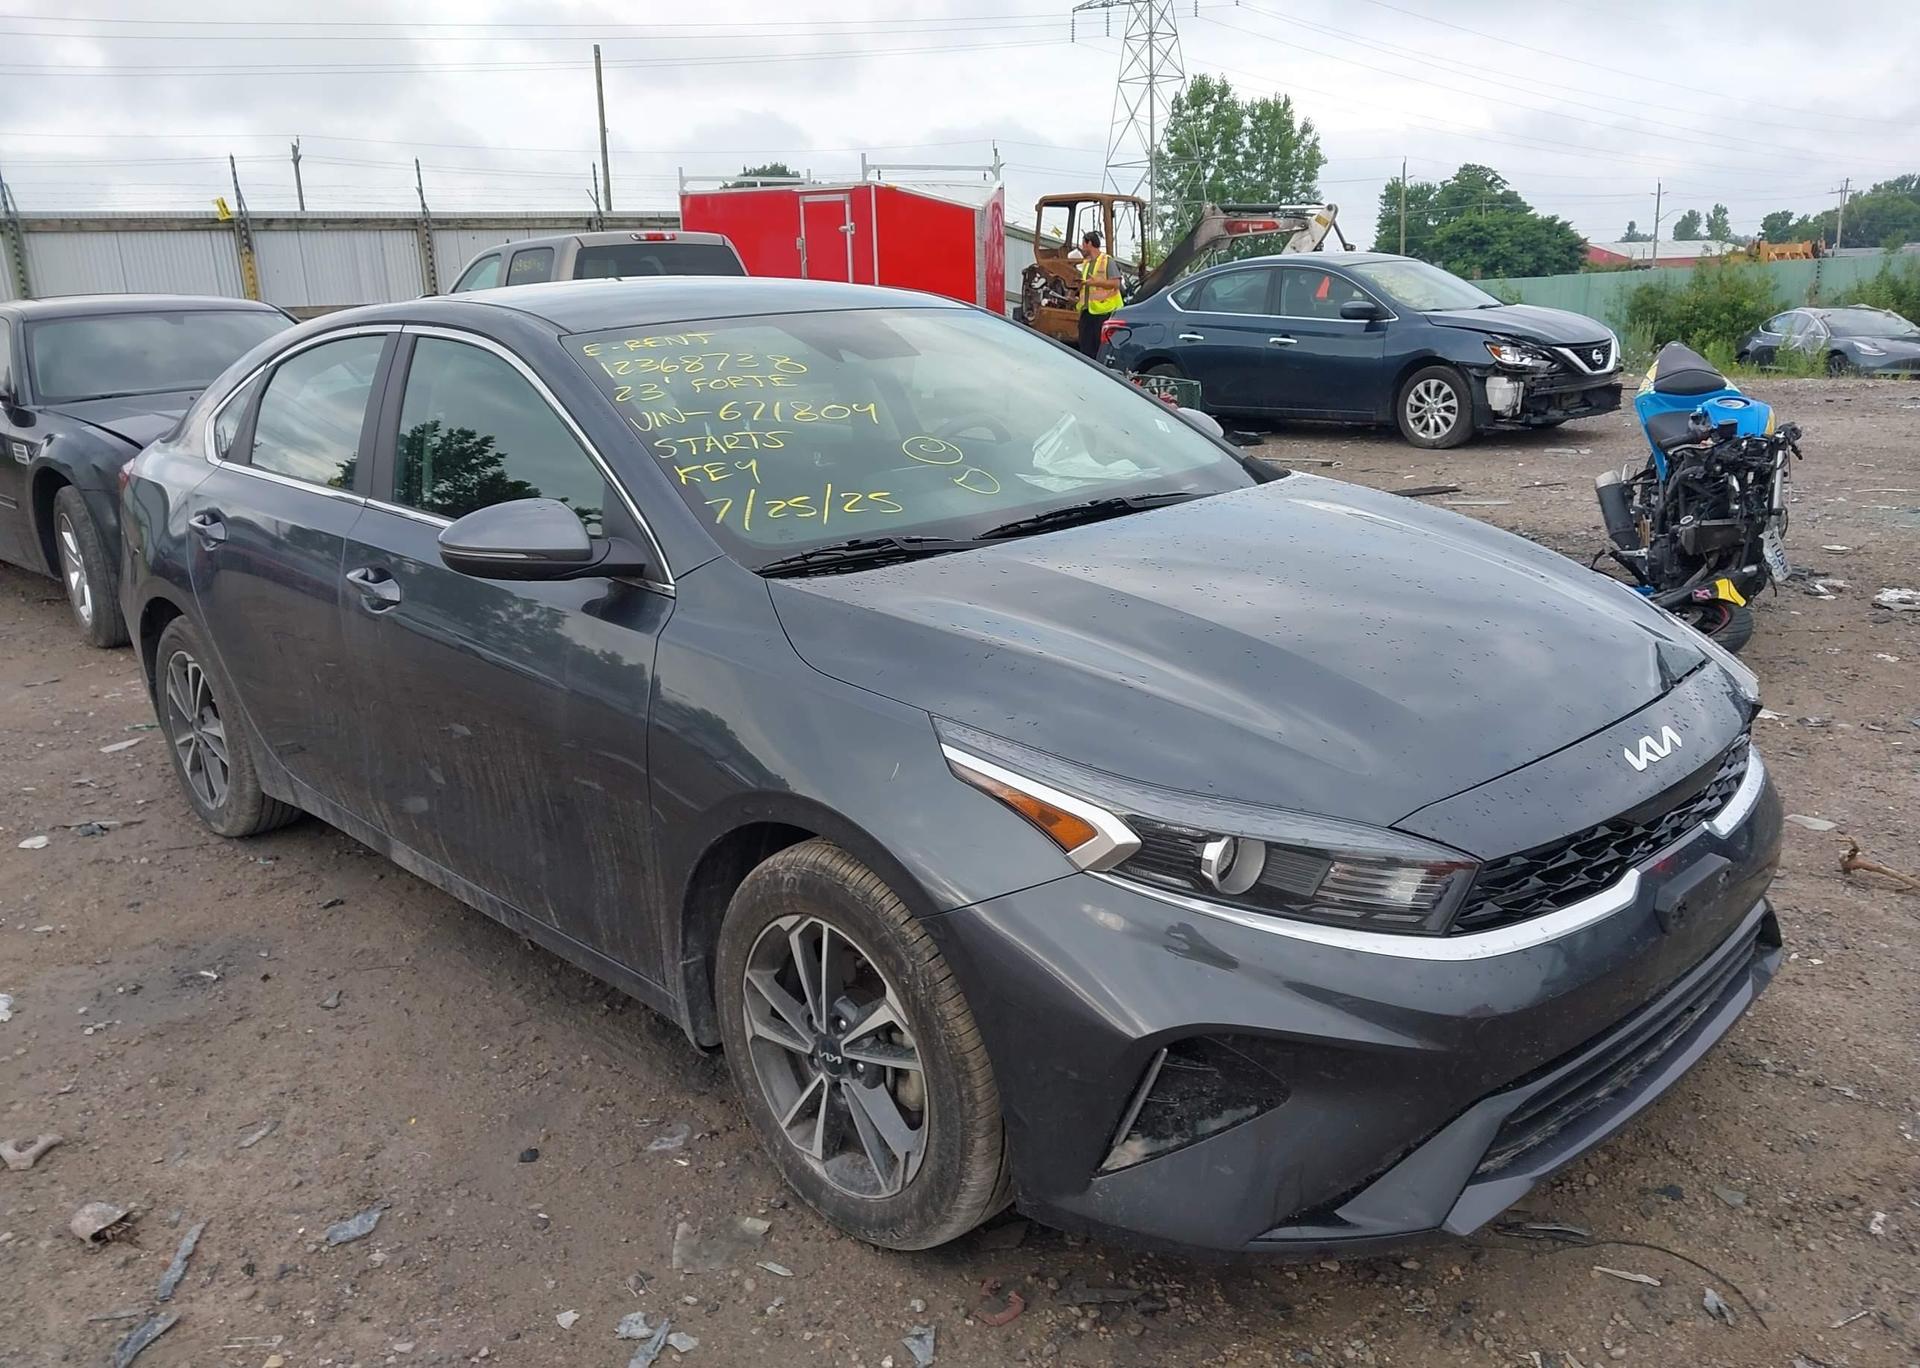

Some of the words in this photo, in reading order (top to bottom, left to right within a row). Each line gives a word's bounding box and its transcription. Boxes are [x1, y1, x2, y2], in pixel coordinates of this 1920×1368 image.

[583, 333, 716, 356] E-RENT
[601, 352, 808, 378] 12368738
[691, 374, 798, 393] FORTE
[654, 431, 794, 459] STARTS
[674, 459, 761, 485] KEY
[704, 483, 903, 531] 7/25/25
[1624, 725, 1682, 771] KIA
